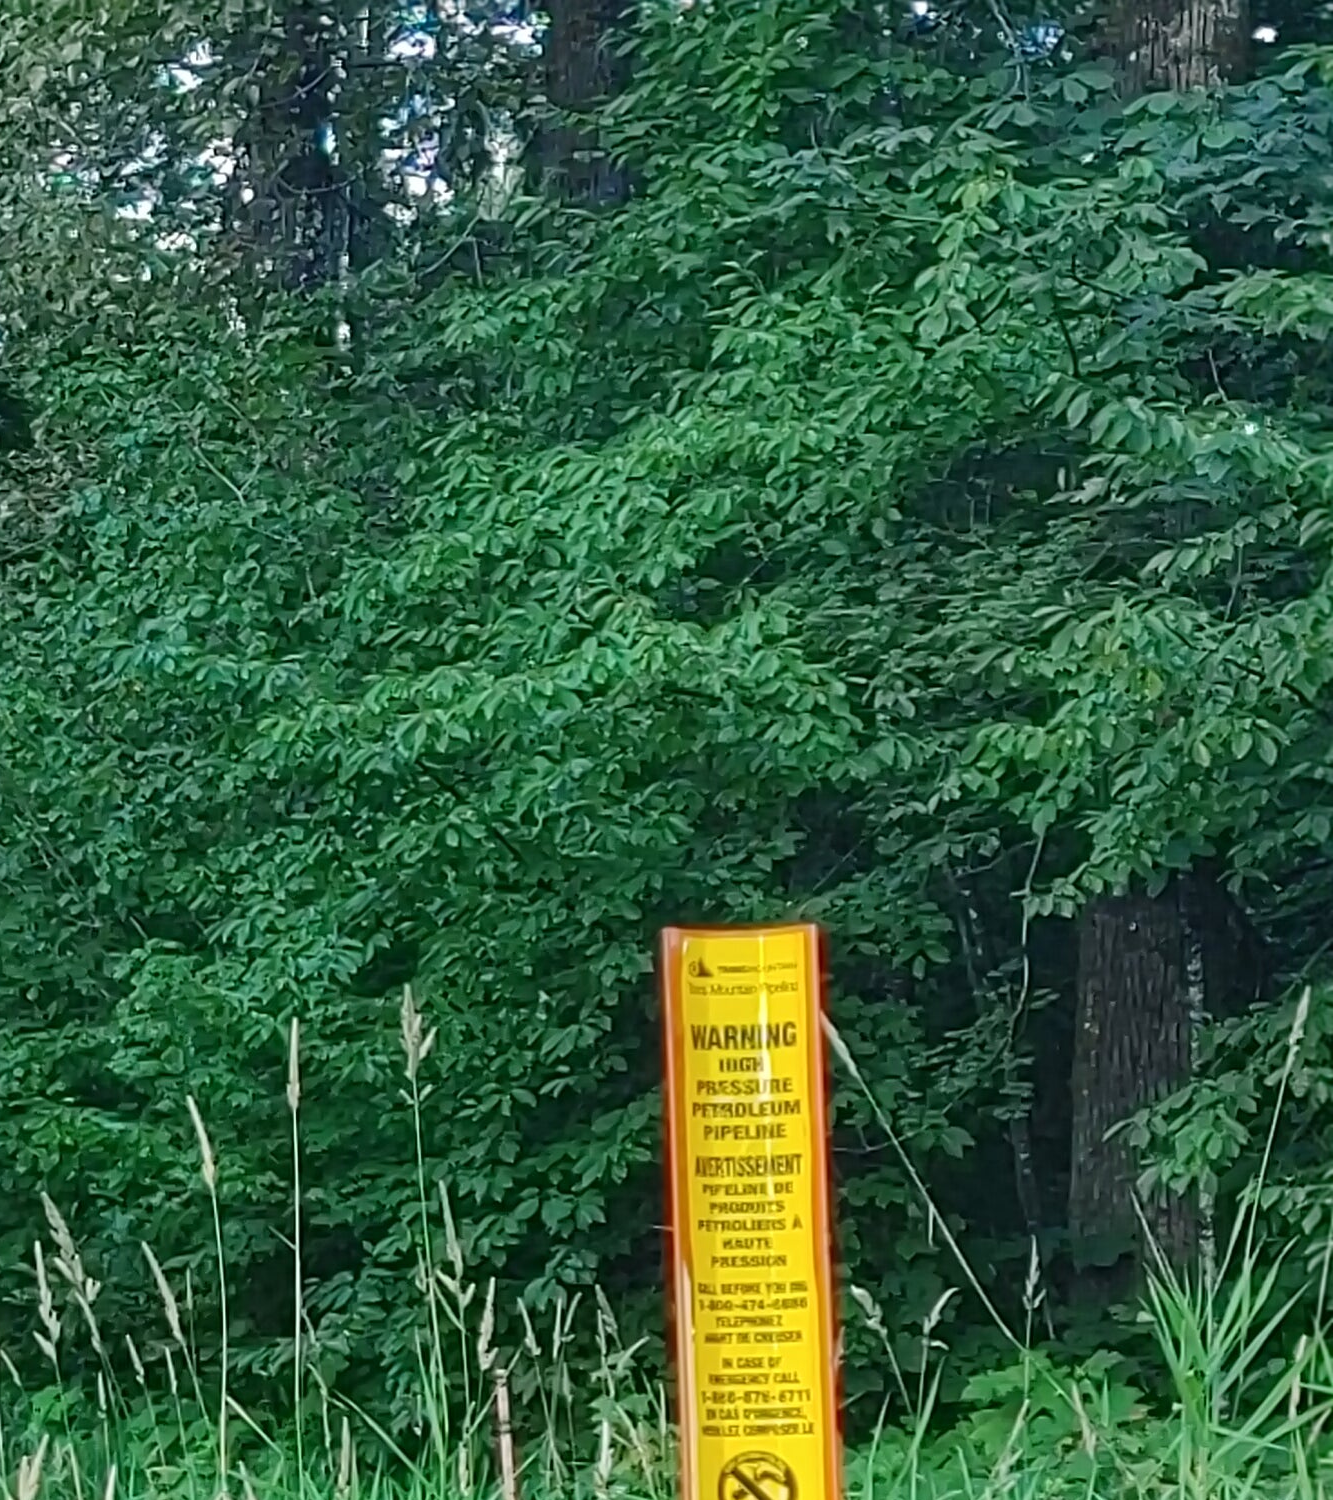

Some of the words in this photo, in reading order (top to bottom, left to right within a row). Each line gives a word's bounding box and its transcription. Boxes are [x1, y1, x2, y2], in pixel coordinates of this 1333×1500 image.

[691, 1022, 797, 1050] WARNING
[719, 1056, 765, 1072] HIGH
[696, 1078, 793, 1095] PRESSURE
[692, 1100, 801, 1118] PETROLEUM
[703, 1123, 787, 1140] PIPELINE
[695, 1154, 802, 1177] AVERTISSEMENT
[702, 1183, 767, 1196] PIPELINE
[774, 1182, 793, 1193] DE
[709, 1201, 786, 1214] PRODUITS
[722, 1238, 773, 1250] HAUTE
[710, 1256, 787, 1268] PRESSION
[773, 1371, 801, 1383] CALL
